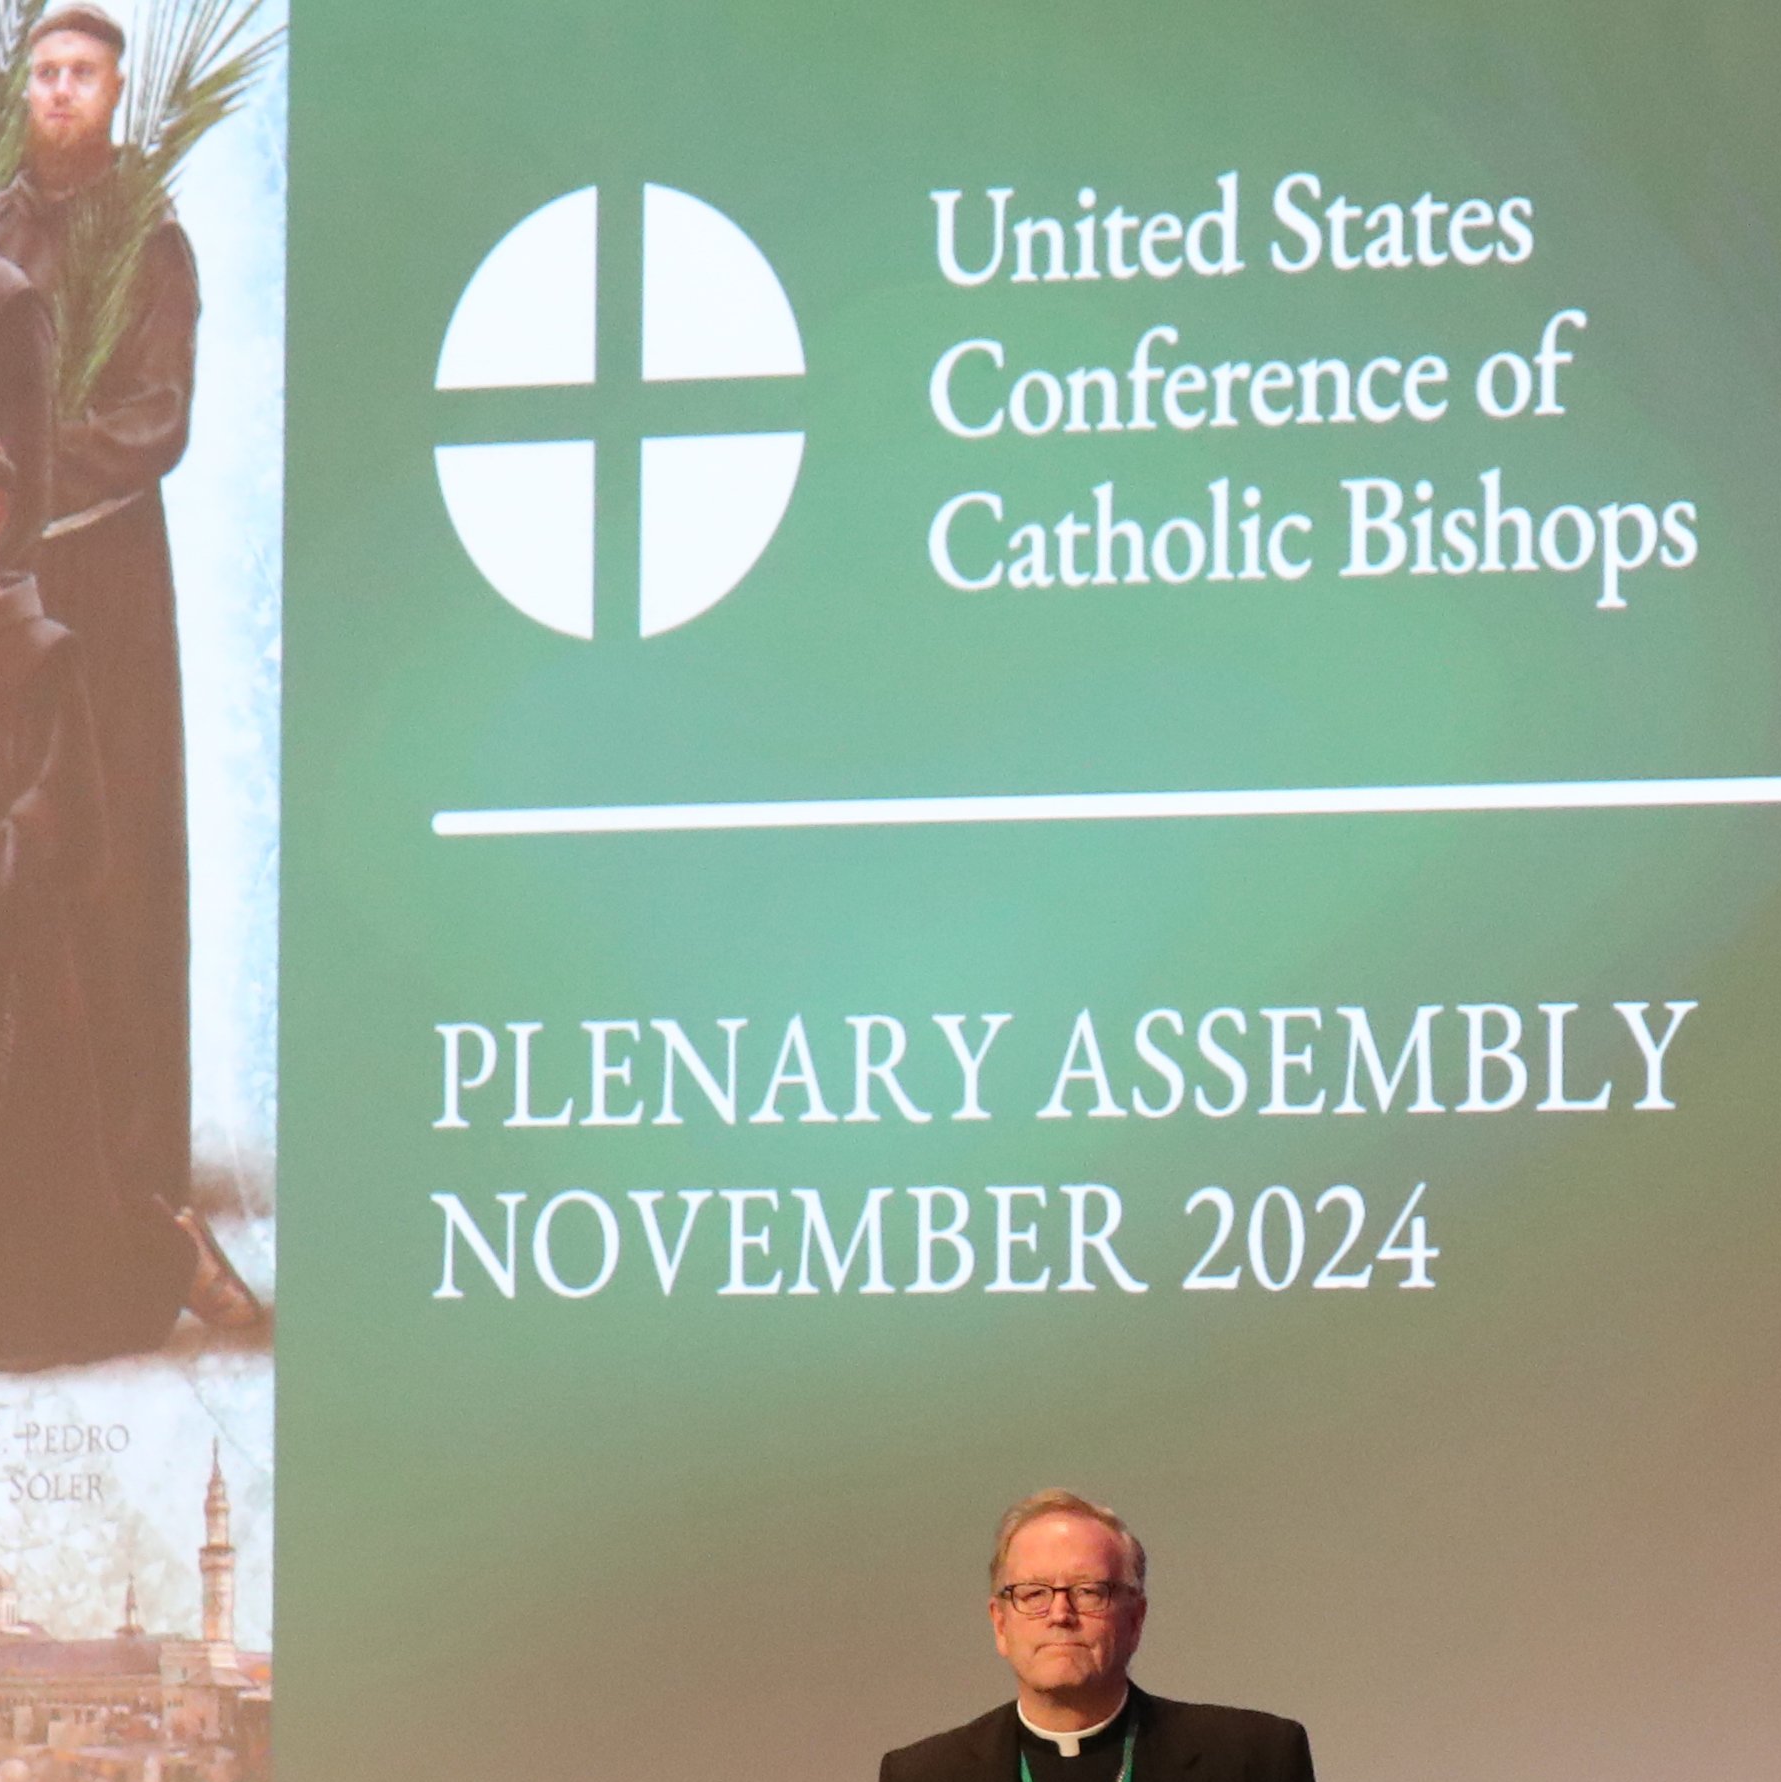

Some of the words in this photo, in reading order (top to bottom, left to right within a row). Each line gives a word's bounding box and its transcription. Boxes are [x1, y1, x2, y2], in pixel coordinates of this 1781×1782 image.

[931, 172, 1246, 286] United
[1271, 172, 1534, 274] States
[929, 325, 1449, 438] Conference
[1476, 310, 1588, 418] of
[928, 478, 1313, 591] Catholic
[1339, 468, 1698, 609] Bishops
[433, 1012, 1013, 1129] PLENARY
[1035, 1001, 1699, 1120] ASSEMBLY
[430, 1184, 1149, 1300] NOVEMBER
[1181, 1183, 1440, 1292] 2024
[9, 1471, 105, 1503] SOLER
[24, 1422, 130, 1455] PEDRO
